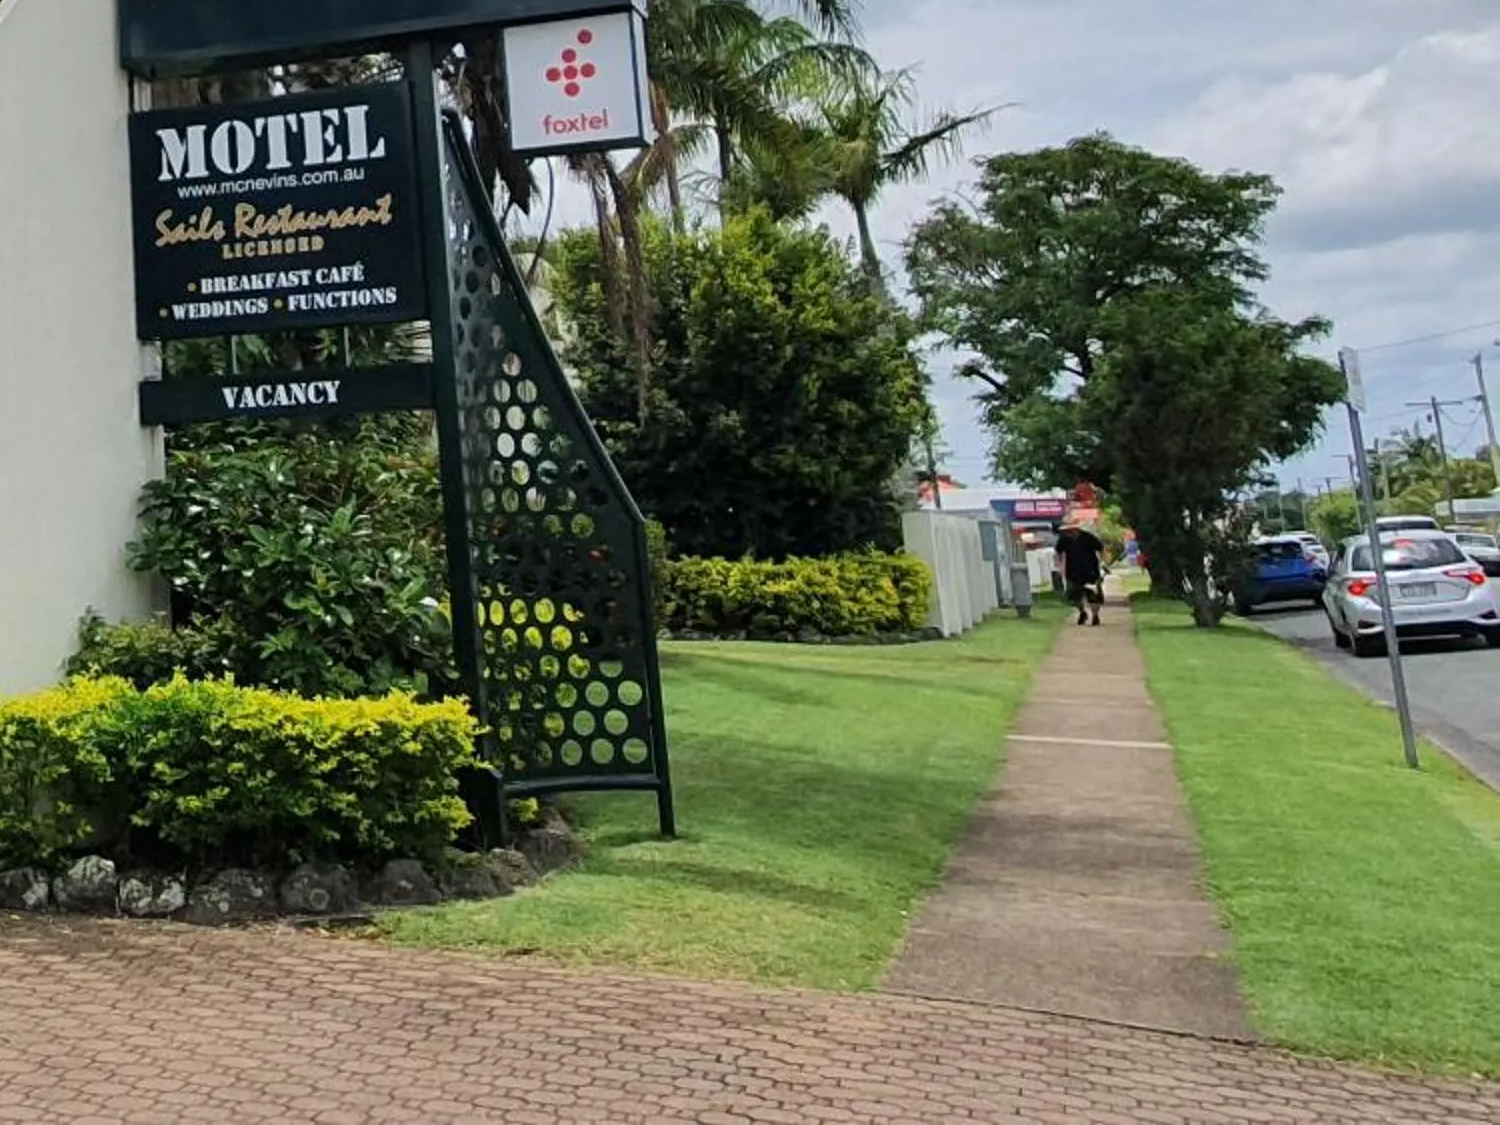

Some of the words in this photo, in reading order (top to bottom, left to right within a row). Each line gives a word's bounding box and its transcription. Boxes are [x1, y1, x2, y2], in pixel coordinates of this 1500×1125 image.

[543, 108, 609, 135] foxtel
[156, 105, 386, 182] MOTEL
[177, 167, 365, 200] www.mcnevins.com.au
[155, 206, 226, 248] Sails
[234, 192, 393, 239] Restaurant
[222, 235, 325, 260] LICENSED
[200, 269, 311, 295] BREAKFAST
[315, 260, 366, 284] CAFÉ
[171, 297, 269, 321] WEDDINGS
[287, 286, 397, 312] FUNCTIONS
[222, 380, 341, 409] VACANCY
